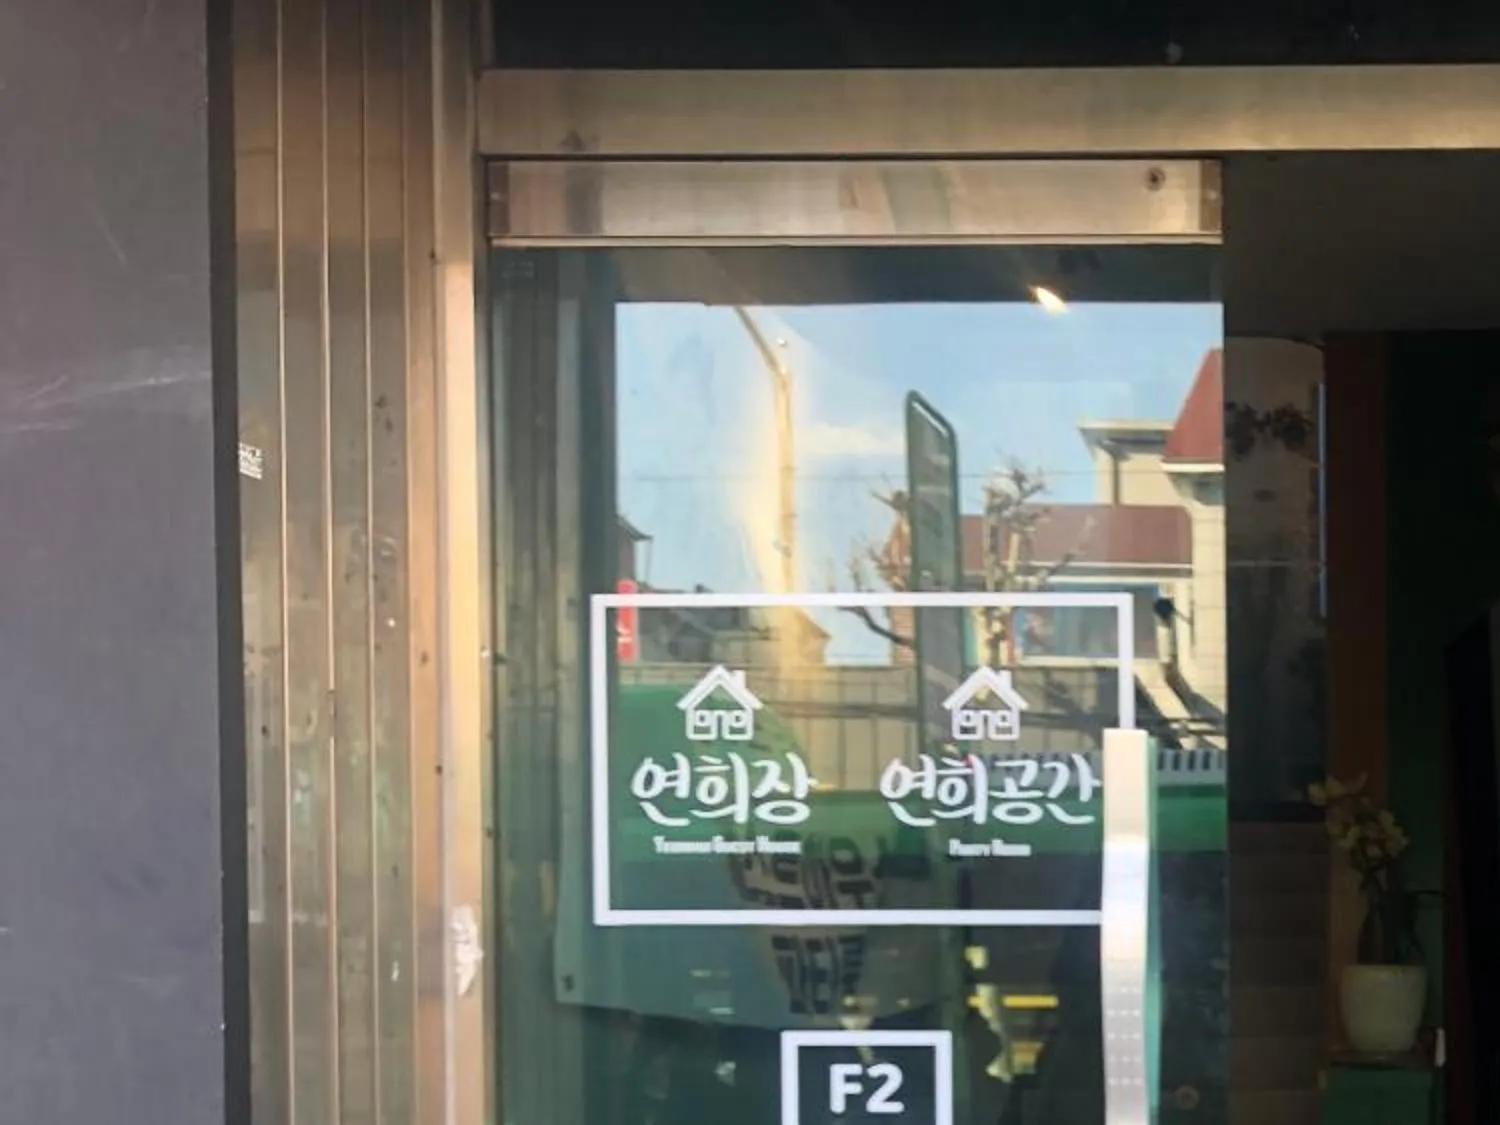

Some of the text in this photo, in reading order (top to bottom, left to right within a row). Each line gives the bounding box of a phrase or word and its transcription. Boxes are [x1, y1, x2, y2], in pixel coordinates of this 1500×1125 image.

[631, 752, 817, 827] 연희장
[879, 752, 1102, 827] 연희공간
[829, 1063, 905, 1114] F2
